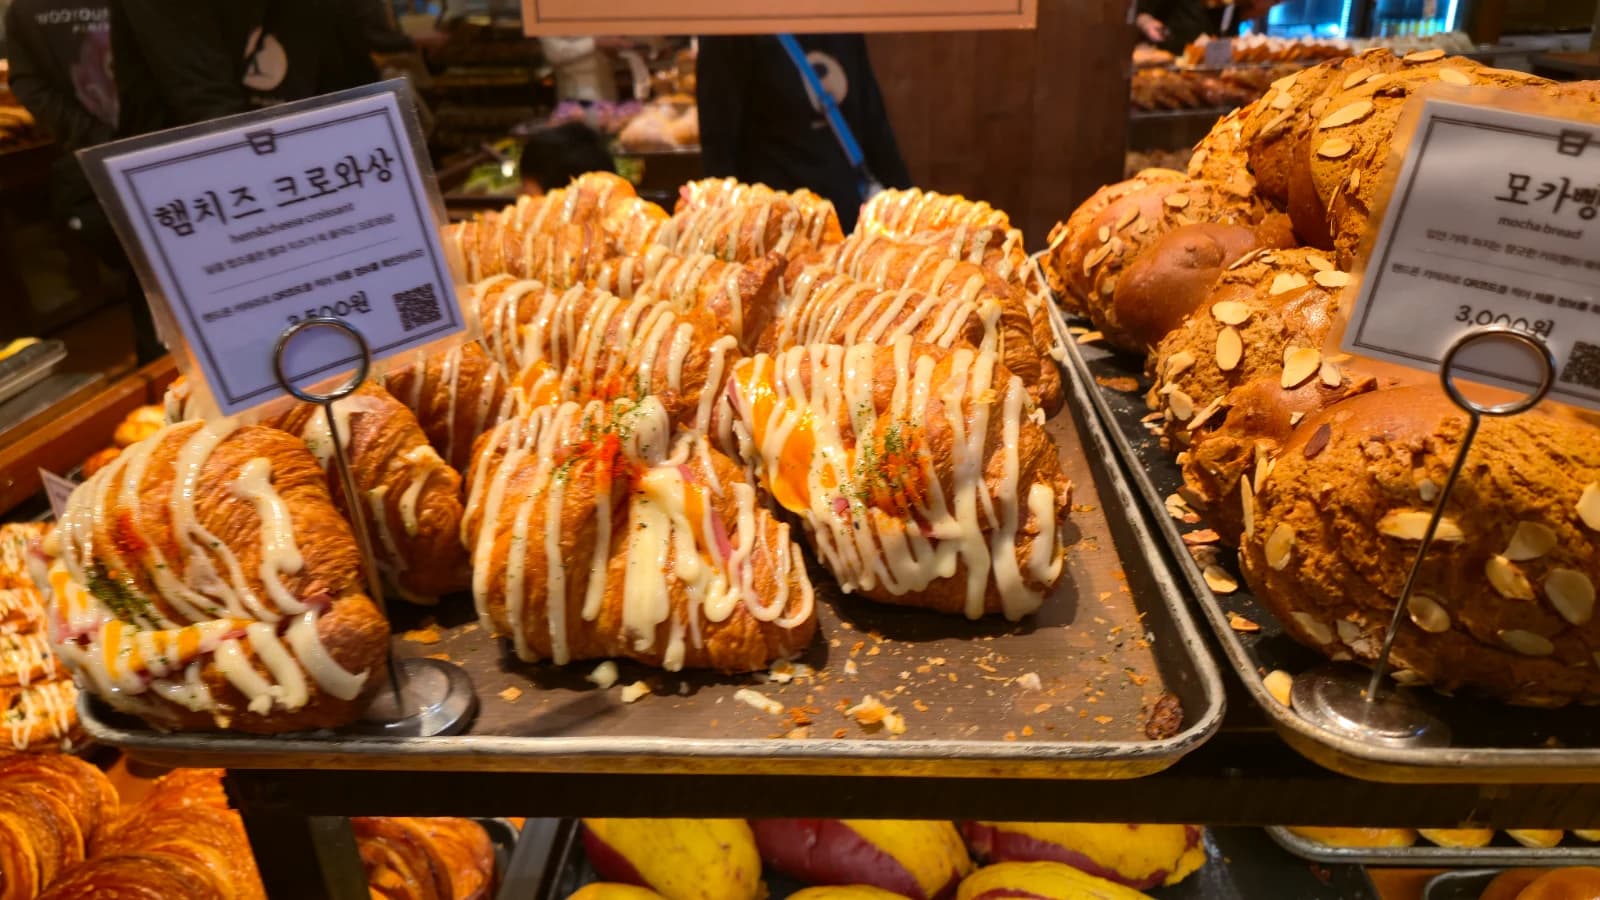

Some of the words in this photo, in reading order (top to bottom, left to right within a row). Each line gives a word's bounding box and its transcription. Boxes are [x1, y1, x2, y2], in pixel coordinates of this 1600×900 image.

[152, 189, 265, 237] 햄치즈
[274, 147, 395, 208] 크로와상
[1498, 216, 1541, 232] mocha
[1543, 223, 1583, 240] bread
